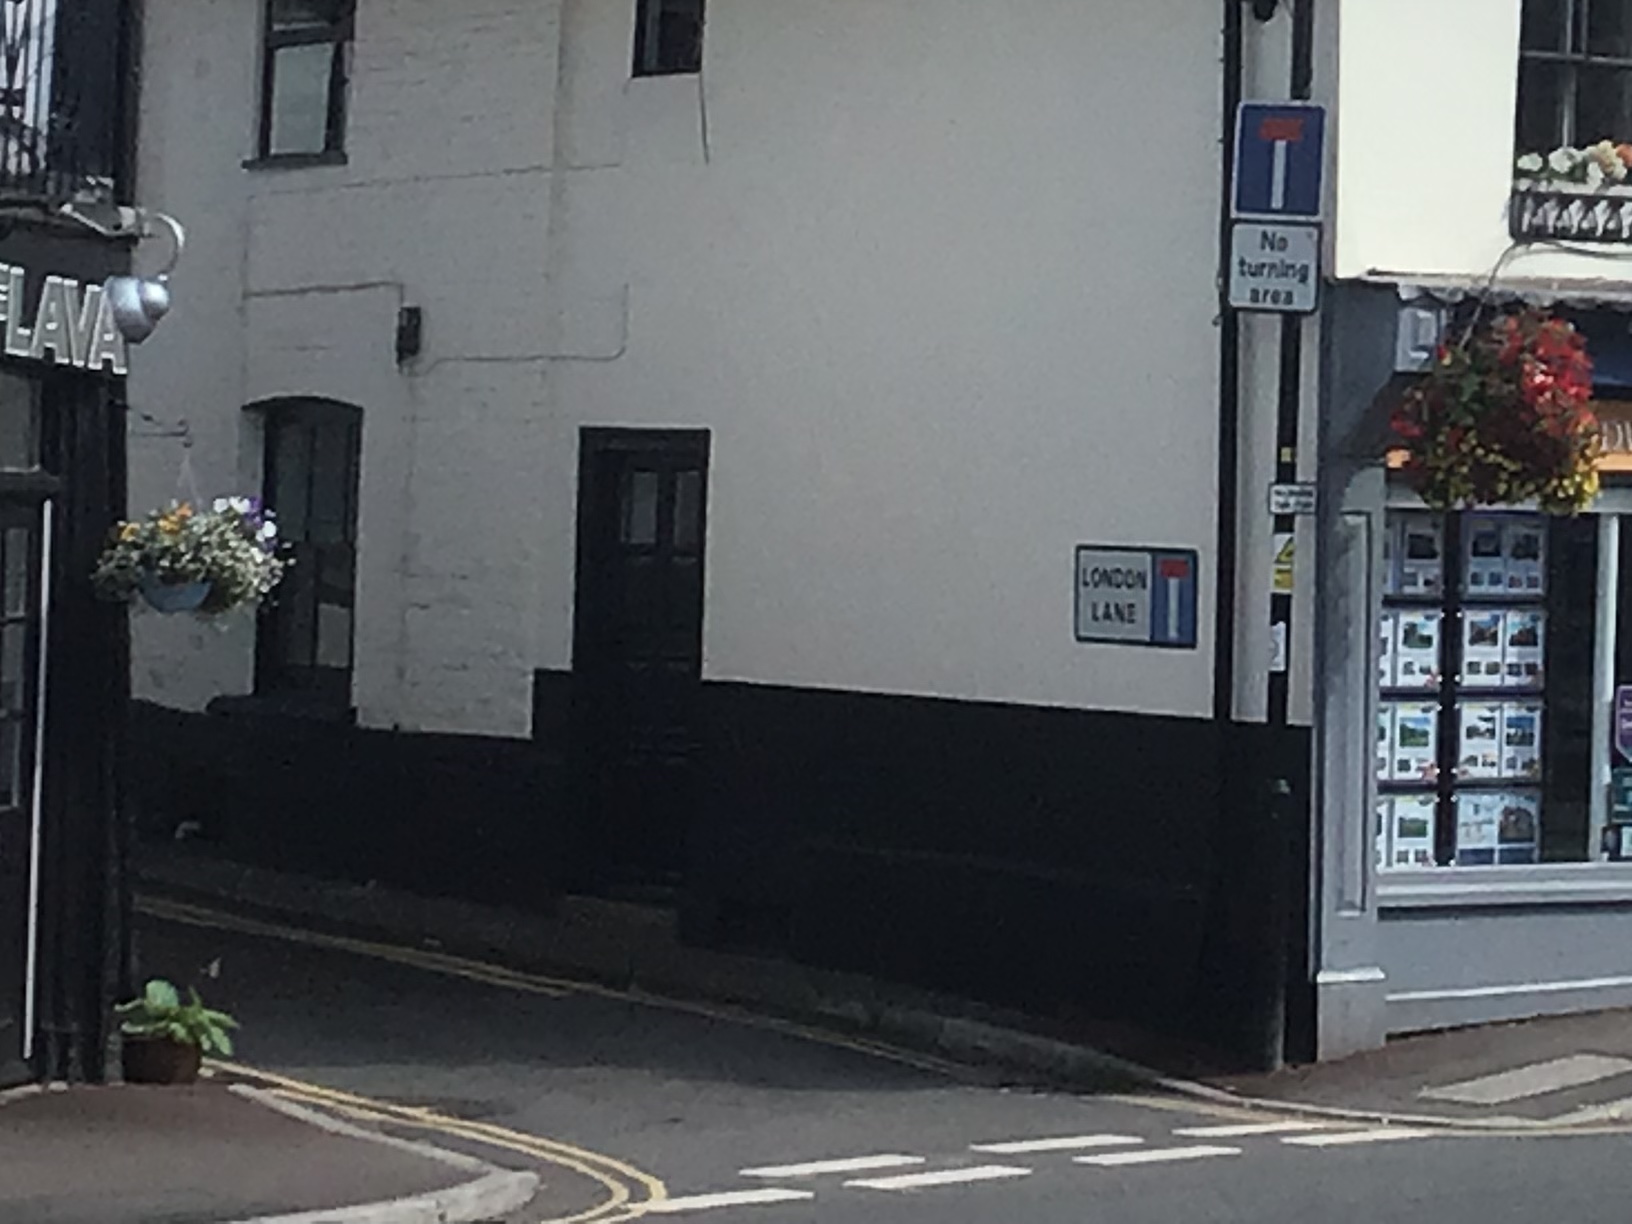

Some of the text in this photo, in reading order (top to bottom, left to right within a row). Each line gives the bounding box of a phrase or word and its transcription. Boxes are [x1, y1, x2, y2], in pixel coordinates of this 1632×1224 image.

[1260, 229, 1288, 251] No
[1238, 256, 1309, 284] turning
[1250, 287, 1293, 305] area
[1082, 566, 1148, 590] LONDON
[1091, 602, 1136, 624] LANE
